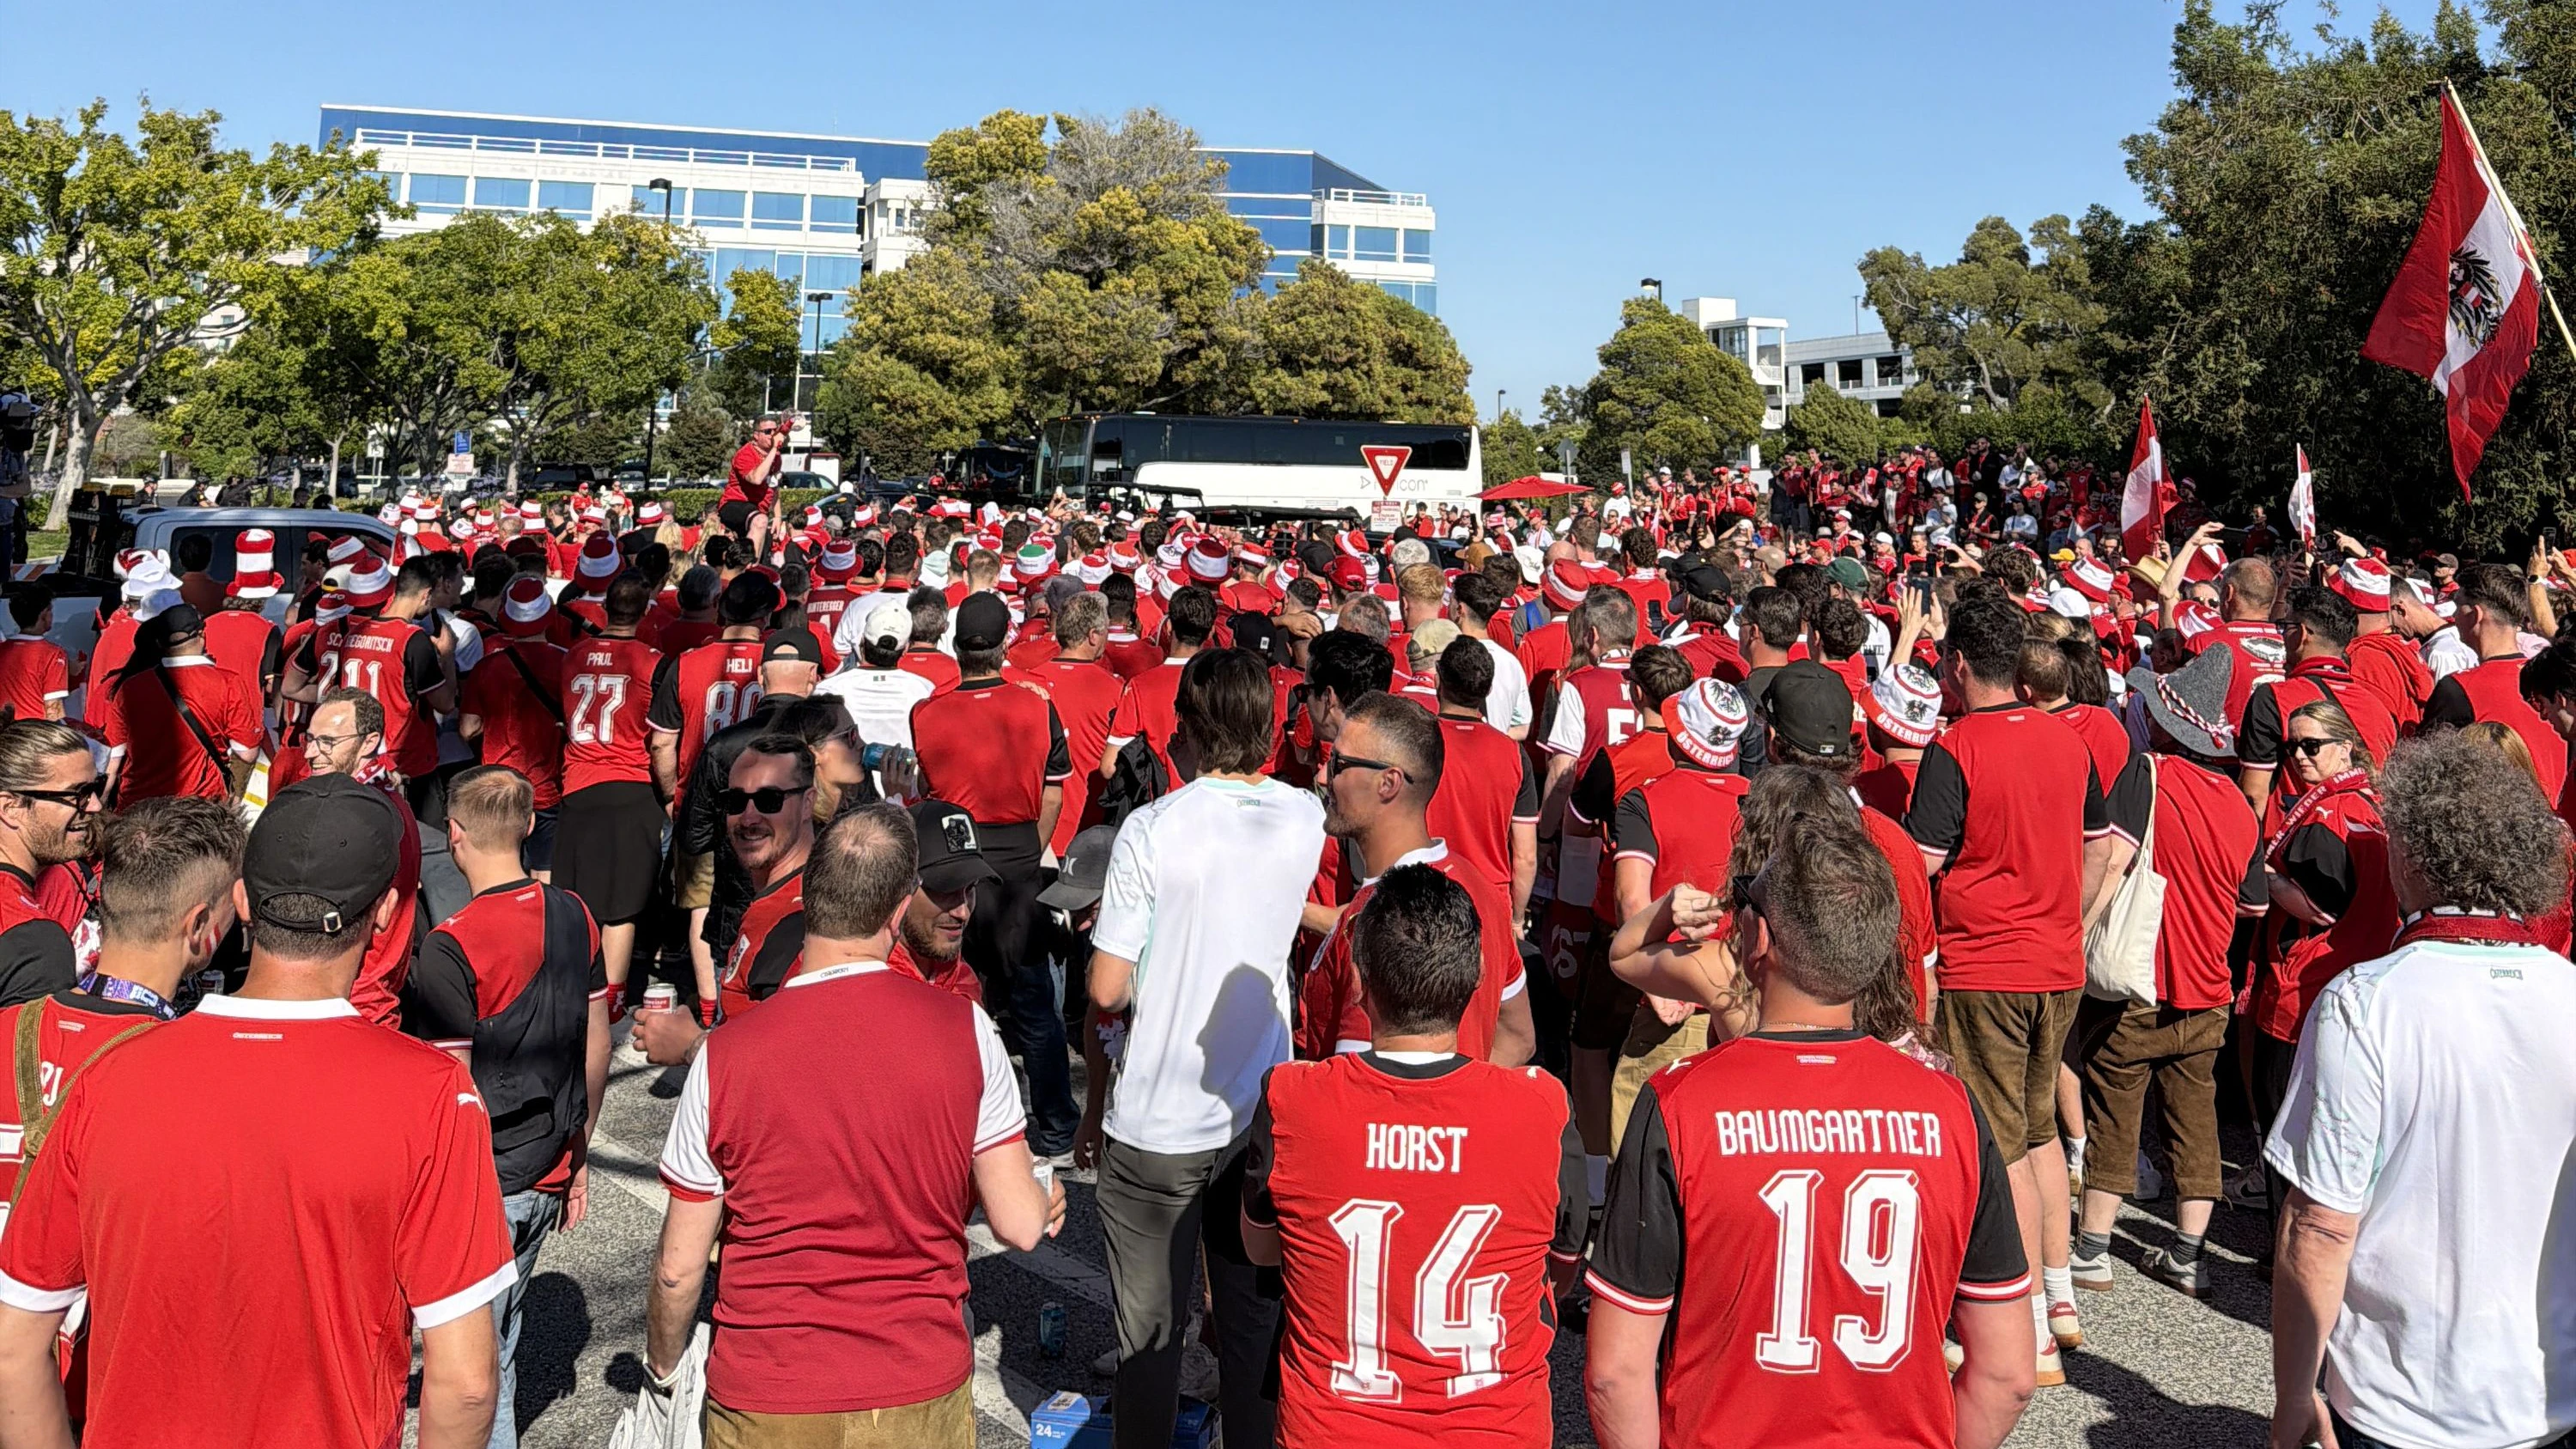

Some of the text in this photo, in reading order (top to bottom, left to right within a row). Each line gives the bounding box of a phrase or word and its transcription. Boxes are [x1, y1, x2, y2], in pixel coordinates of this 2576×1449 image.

[344, 658, 382, 701] 11
[586, 652, 612, 666] PAUL
[726, 658, 752, 673] HELI
[571, 673, 631, 745] 27
[2286, 785, 2327, 825] WIEDER
[1365, 1123, 1467, 1173] HORST
[1716, 1109, 1941, 1157] BAUMGARTNER
[1756, 1169, 1922, 1373] 19
[1327, 1197, 1510, 1404] 14
[1036, 1423, 1052, 1437] 24
